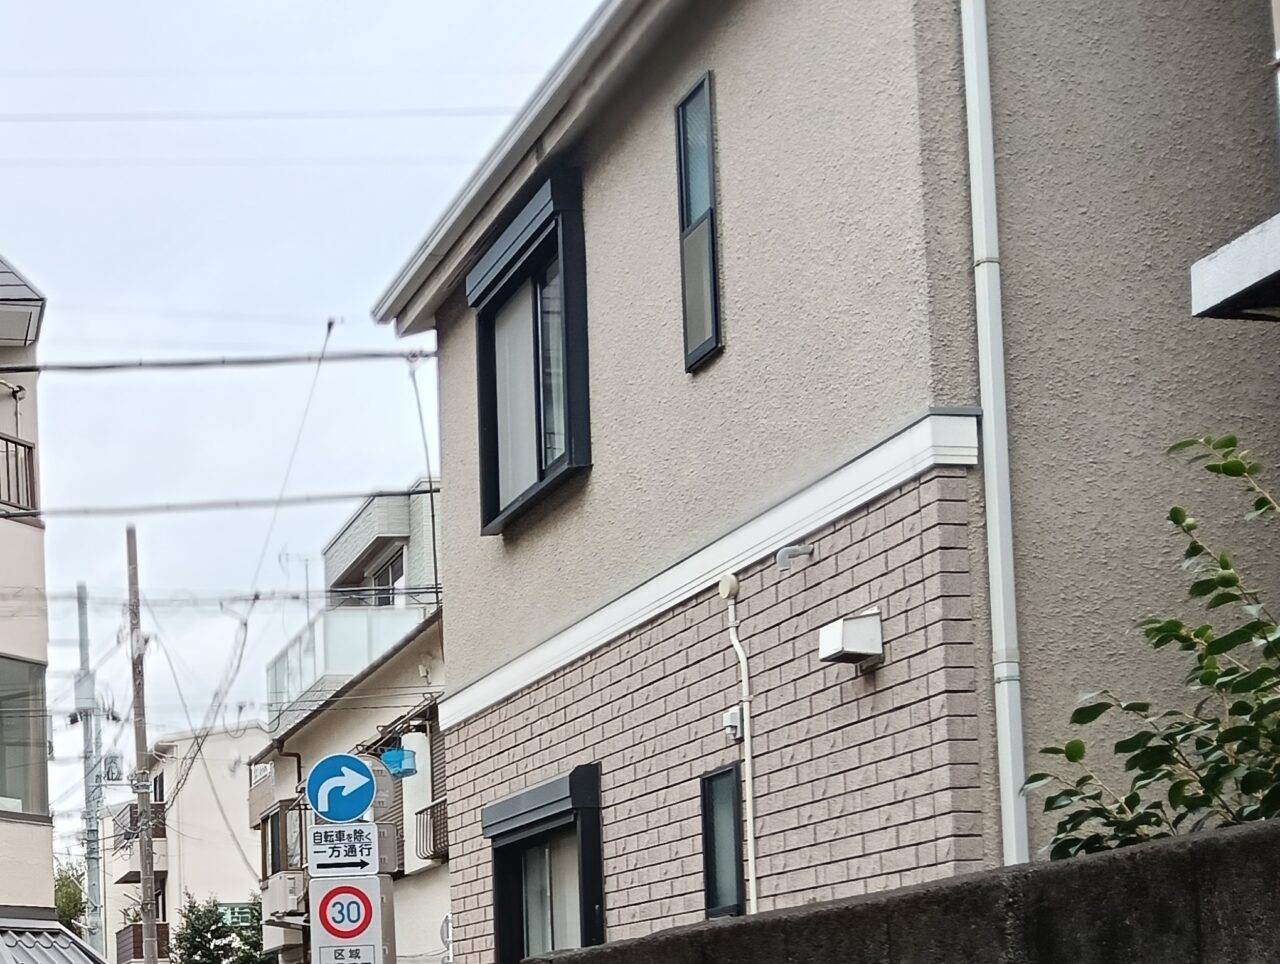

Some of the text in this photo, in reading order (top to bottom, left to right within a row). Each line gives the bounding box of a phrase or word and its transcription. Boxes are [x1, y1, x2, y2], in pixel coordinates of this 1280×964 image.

[313, 829, 371, 844] 自転車を除く
[313, 844, 373, 858] 一方通行
[331, 901, 361, 924] 30
[334, 948, 361, 960] 区域
